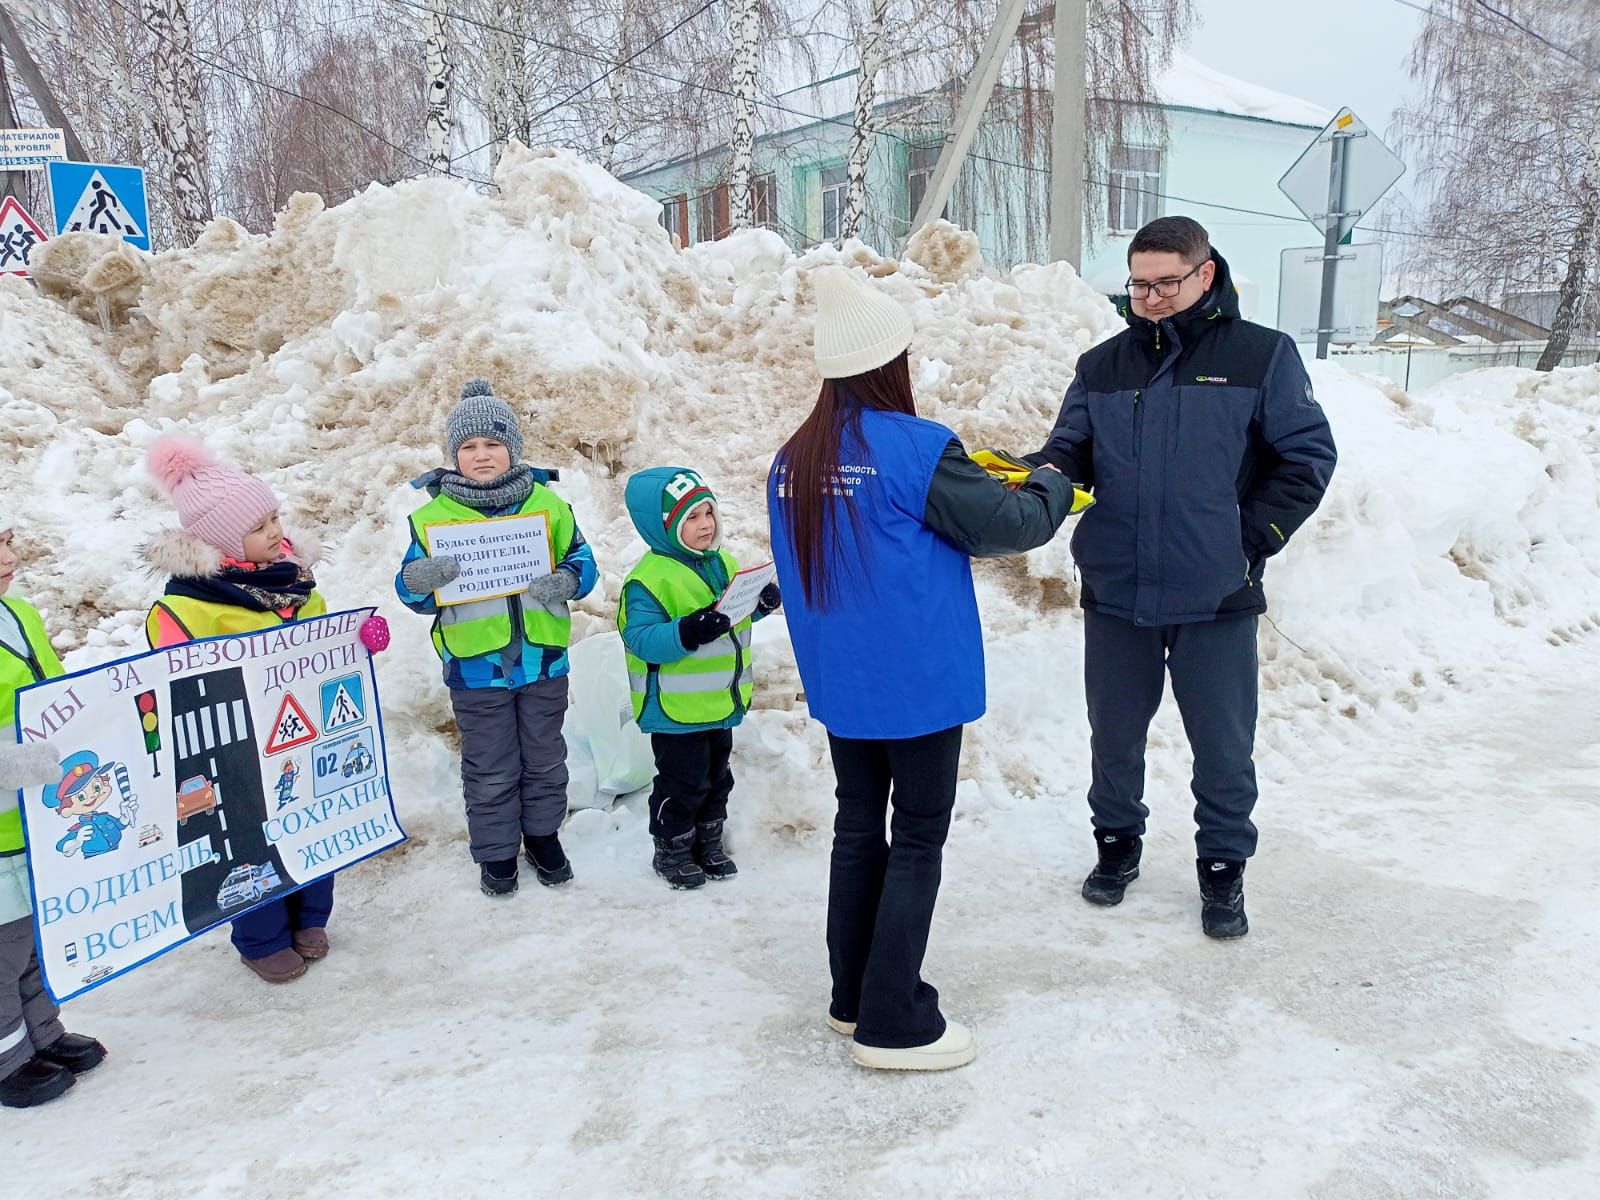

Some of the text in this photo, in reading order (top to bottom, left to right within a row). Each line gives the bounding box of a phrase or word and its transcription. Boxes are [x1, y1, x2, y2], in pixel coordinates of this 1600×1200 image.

[14, 143, 52, 152] КРОВЛЯ
[820, 463, 878, 476] ОАСНОСТЬ
[436, 529, 542, 551] Будьте бдительны
[458, 572, 534, 593] РОДИТЕЛИ!
[460, 559, 541, 578] об не плакали
[22, 612, 361, 744] МЫ ЗА БЕЗОПАСНЫЕ
[264, 643, 369, 696] ДОРОГИ
[316, 752, 338, 778] 02
[264, 776, 388, 843] СОХРАНИ
[297, 812, 394, 871] ЖИЗНЬ!
[39, 840, 221, 927] ВОДИТЕЛЬ,
[82, 900, 180, 962] ВСЕМ
